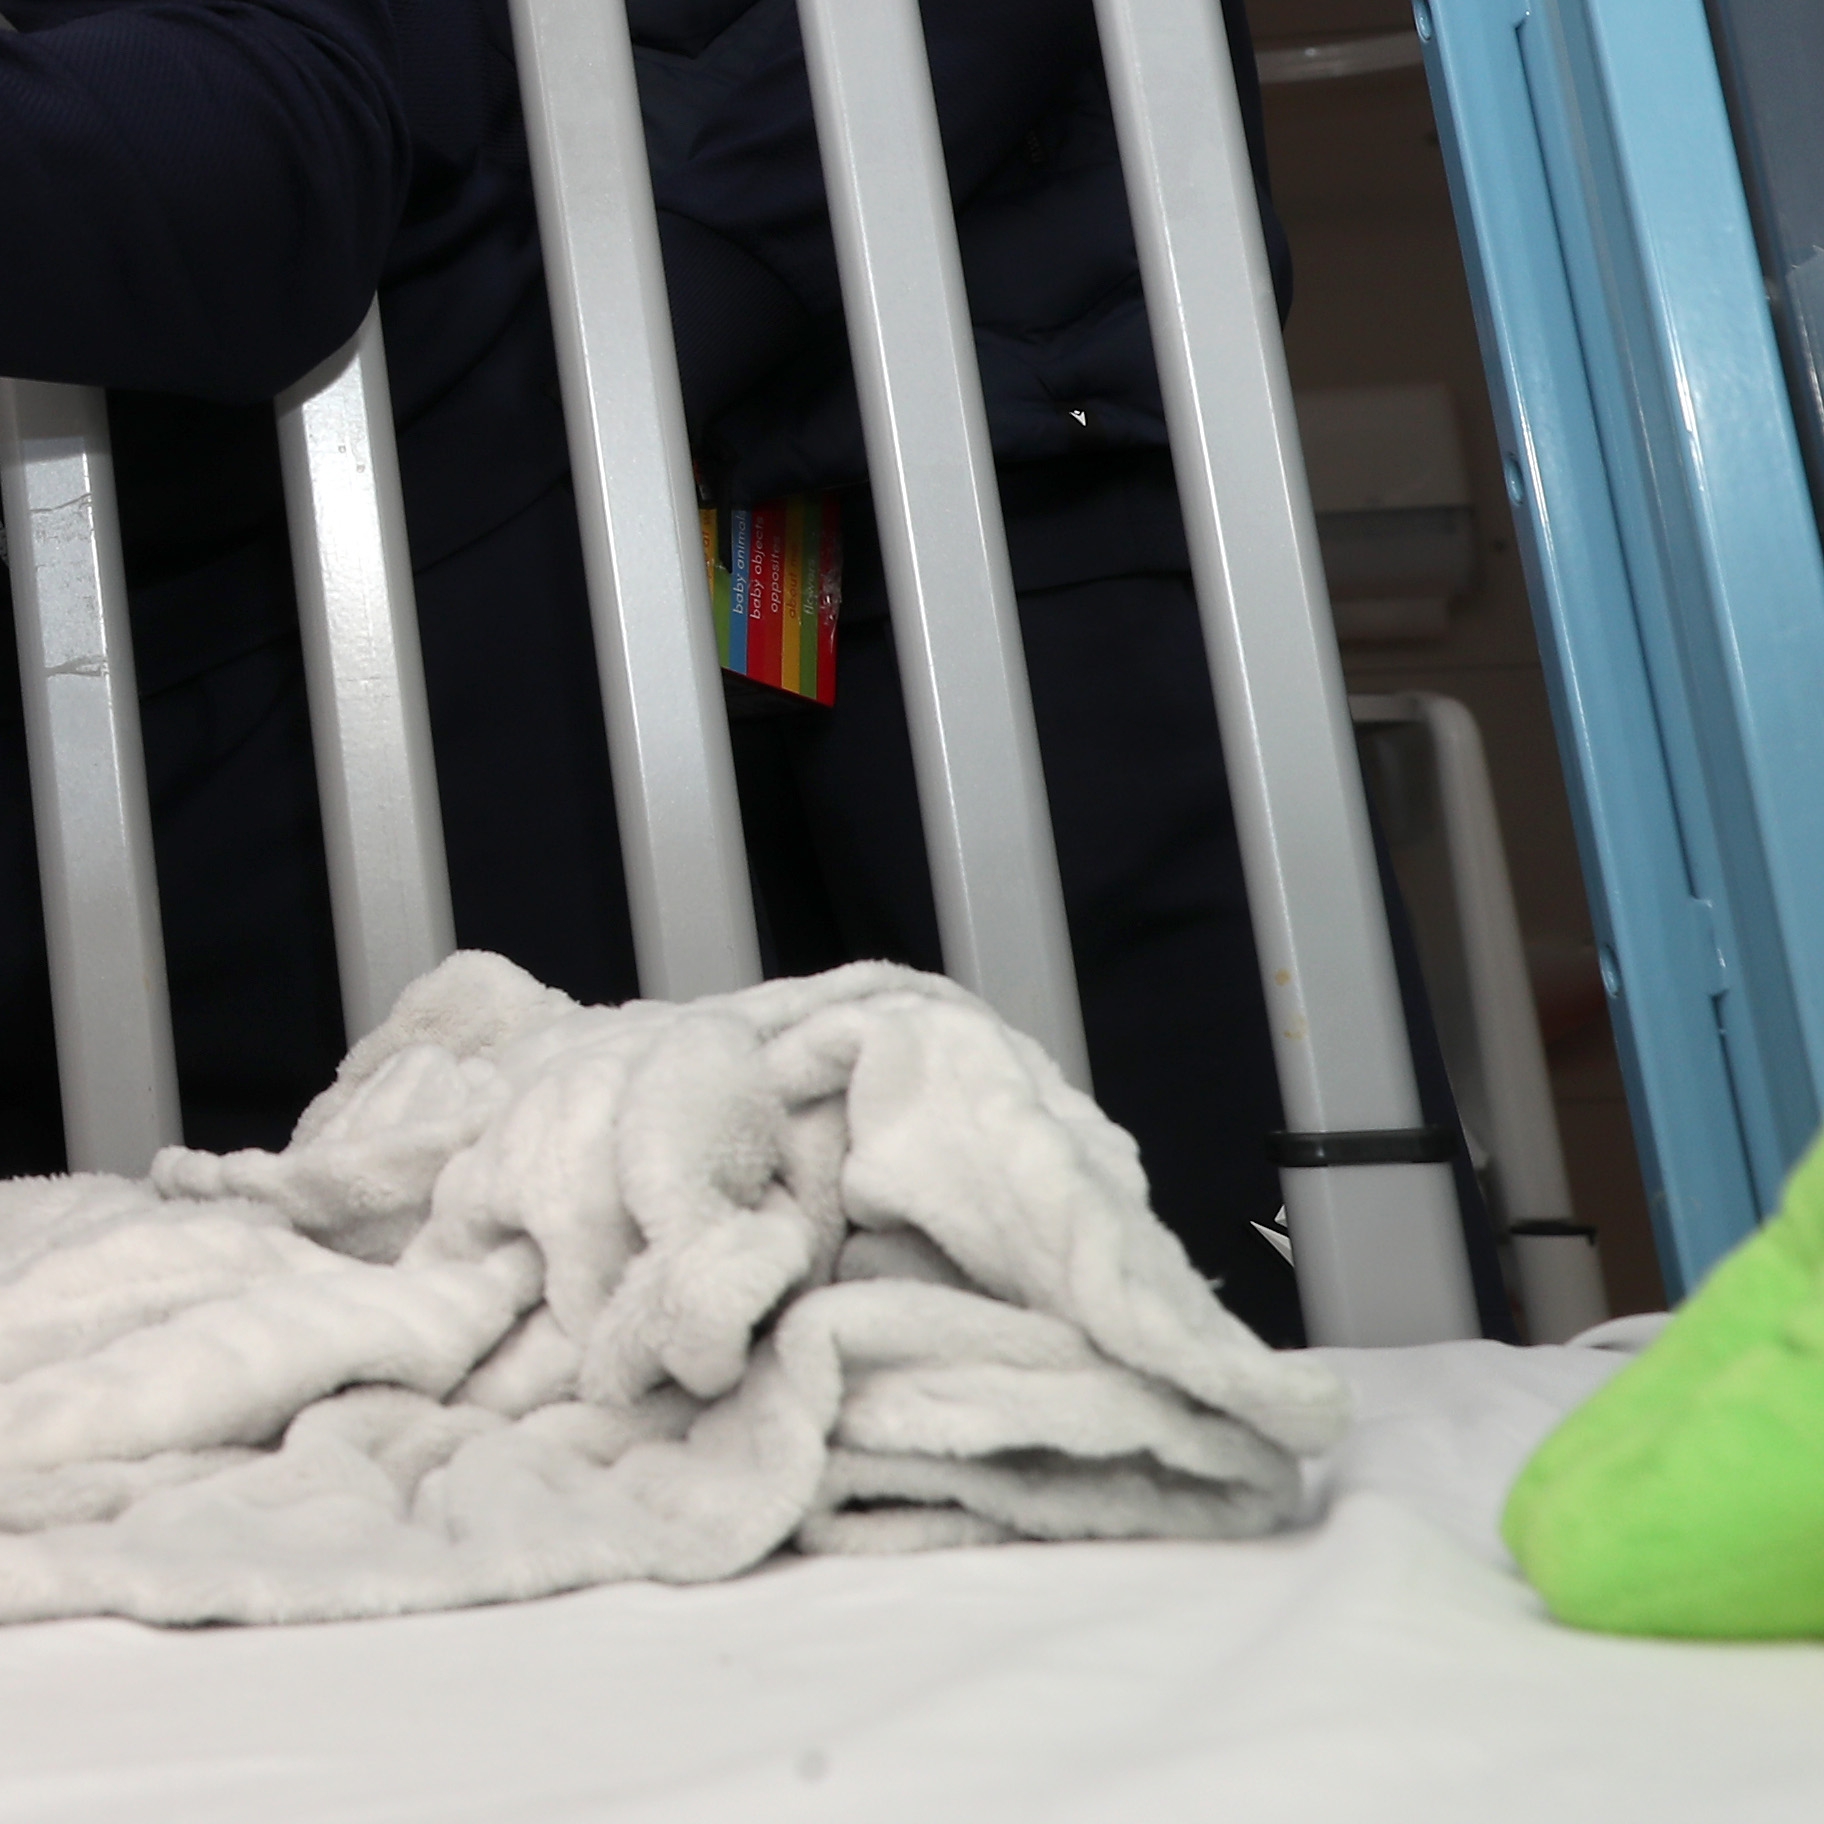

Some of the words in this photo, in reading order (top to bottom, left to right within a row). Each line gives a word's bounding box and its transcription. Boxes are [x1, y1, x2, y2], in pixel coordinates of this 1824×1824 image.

[735, 509, 748, 570] animals
[751, 516, 765, 575] objects
[733, 574, 747, 615] baby
[749, 579, 765, 620] baby
[770, 535, 782, 613] opposites
[786, 572, 799, 619] about
